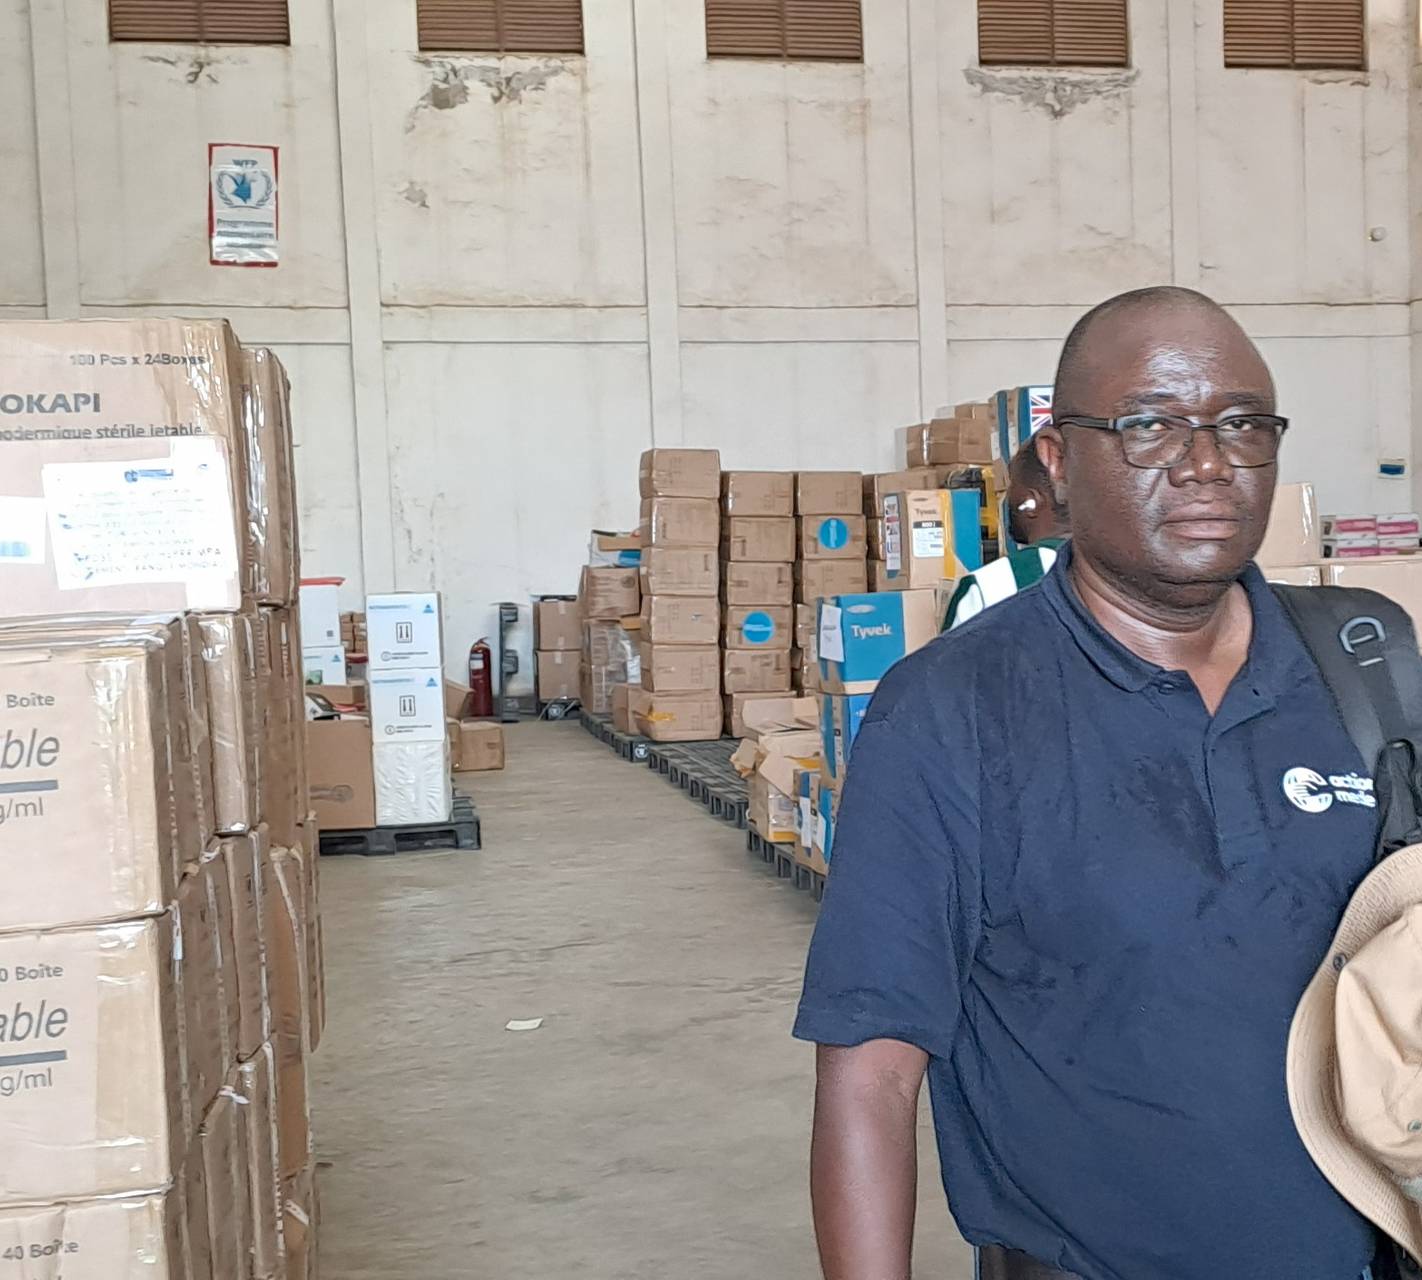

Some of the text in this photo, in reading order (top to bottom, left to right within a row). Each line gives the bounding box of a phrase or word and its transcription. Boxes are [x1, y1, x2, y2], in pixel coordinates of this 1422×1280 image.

[0, 393, 101, 413] OKAPI
[96, 424, 144, 439] stérile
[850, 623, 892, 640] Tyvek
[6, 692, 55, 708] Boîte
[16, 963, 63, 981] Boîte
